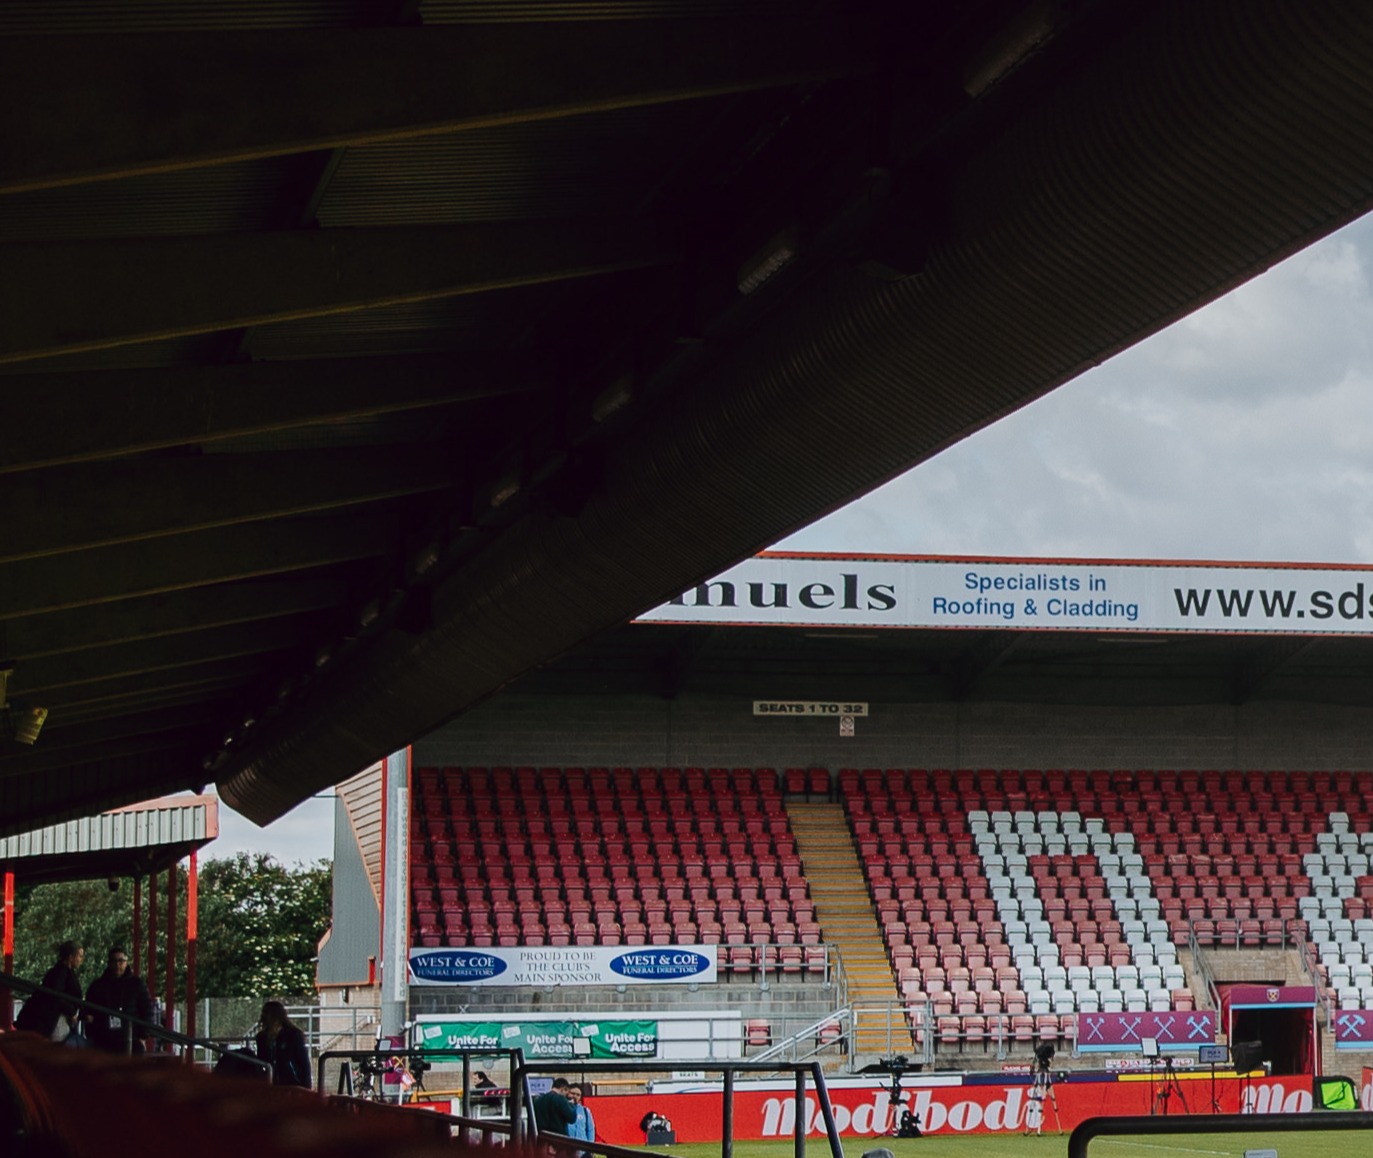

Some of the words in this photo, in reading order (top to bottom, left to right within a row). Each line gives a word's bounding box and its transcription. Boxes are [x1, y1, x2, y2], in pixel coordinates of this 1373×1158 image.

[964, 573, 1081, 596] Specialists
[1089, 574, 1107, 592] in
[932, 598, 1015, 619] Roofing
[1023, 600, 1038, 616] &
[1046, 599, 1139, 620] Cladding
[759, 703, 805, 713] SEATS
[808, 704, 816, 713] 1
[819, 704, 839, 713] TO
[843, 704, 863, 714] 32
[417, 956, 453, 967] WEST
[454, 957, 467, 967] &
[468, 955, 495, 967] COE
[519, 951, 563, 962] PROUD
[564, 951, 581, 961] TO
[582, 951, 597, 961] BE
[621, 954, 659, 966] WEST
[660, 954, 672, 965] &
[673, 953, 699, 965] COE
[525, 962, 551, 972] THE
[552, 962, 591, 971] CLUB'S
[656, 965, 698, 974] DIRECTORS
[514, 973, 547, 983] MAIN
[548, 971, 602, 982] SPONSOR
[448, 1034, 478, 1046] Unite
[478, 1034, 498, 1045] For
[526, 1033, 556, 1046] Unite
[605, 1032, 637, 1044] Unite
[637, 1033, 656, 1044] For
[531, 1043, 574, 1055] Acces
[609, 1041, 655, 1053] Access
